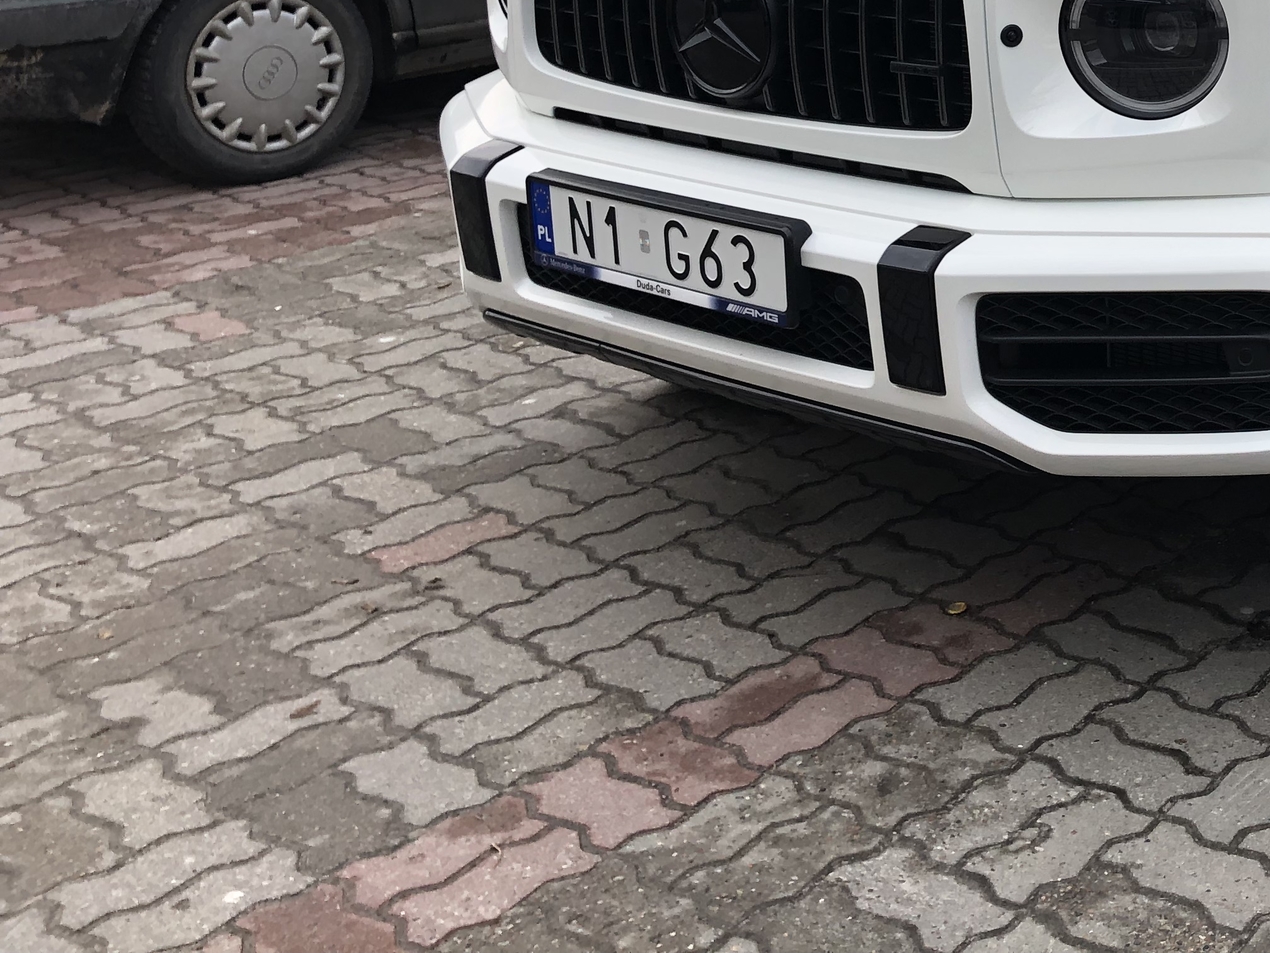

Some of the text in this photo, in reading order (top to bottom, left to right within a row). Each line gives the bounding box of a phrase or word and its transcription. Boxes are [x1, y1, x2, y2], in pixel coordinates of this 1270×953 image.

[537, 224, 552, 243] PL
[567, 195, 757, 298] N1 G63
[550, 257, 586, 274] Mercedes-Benz
[636, 279, 671, 297] Duda-Cars
